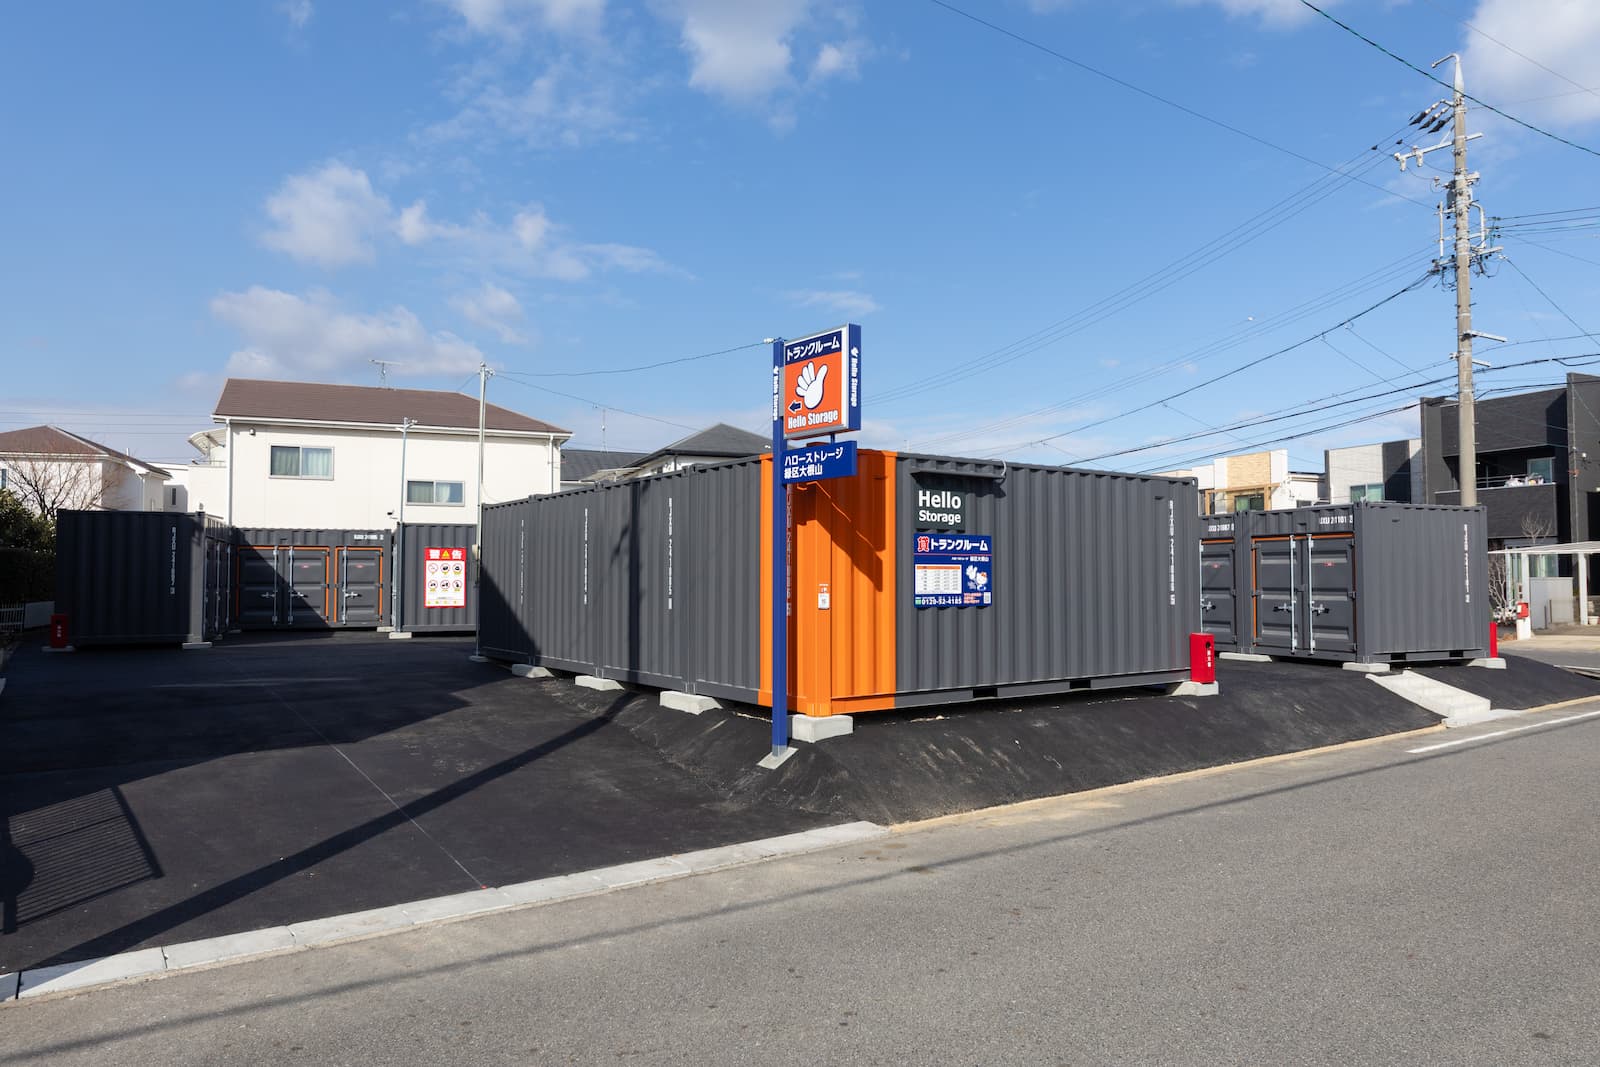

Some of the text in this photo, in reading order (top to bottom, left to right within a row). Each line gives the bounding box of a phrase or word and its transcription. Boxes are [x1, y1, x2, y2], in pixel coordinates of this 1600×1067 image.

[786, 336, 840, 361] トランクルーム
[788, 410, 838, 429] Hello Storage
[784, 446, 843, 466] ハローストレージ
[919, 490, 961, 509] Hello
[919, 510, 961, 525] Storage
